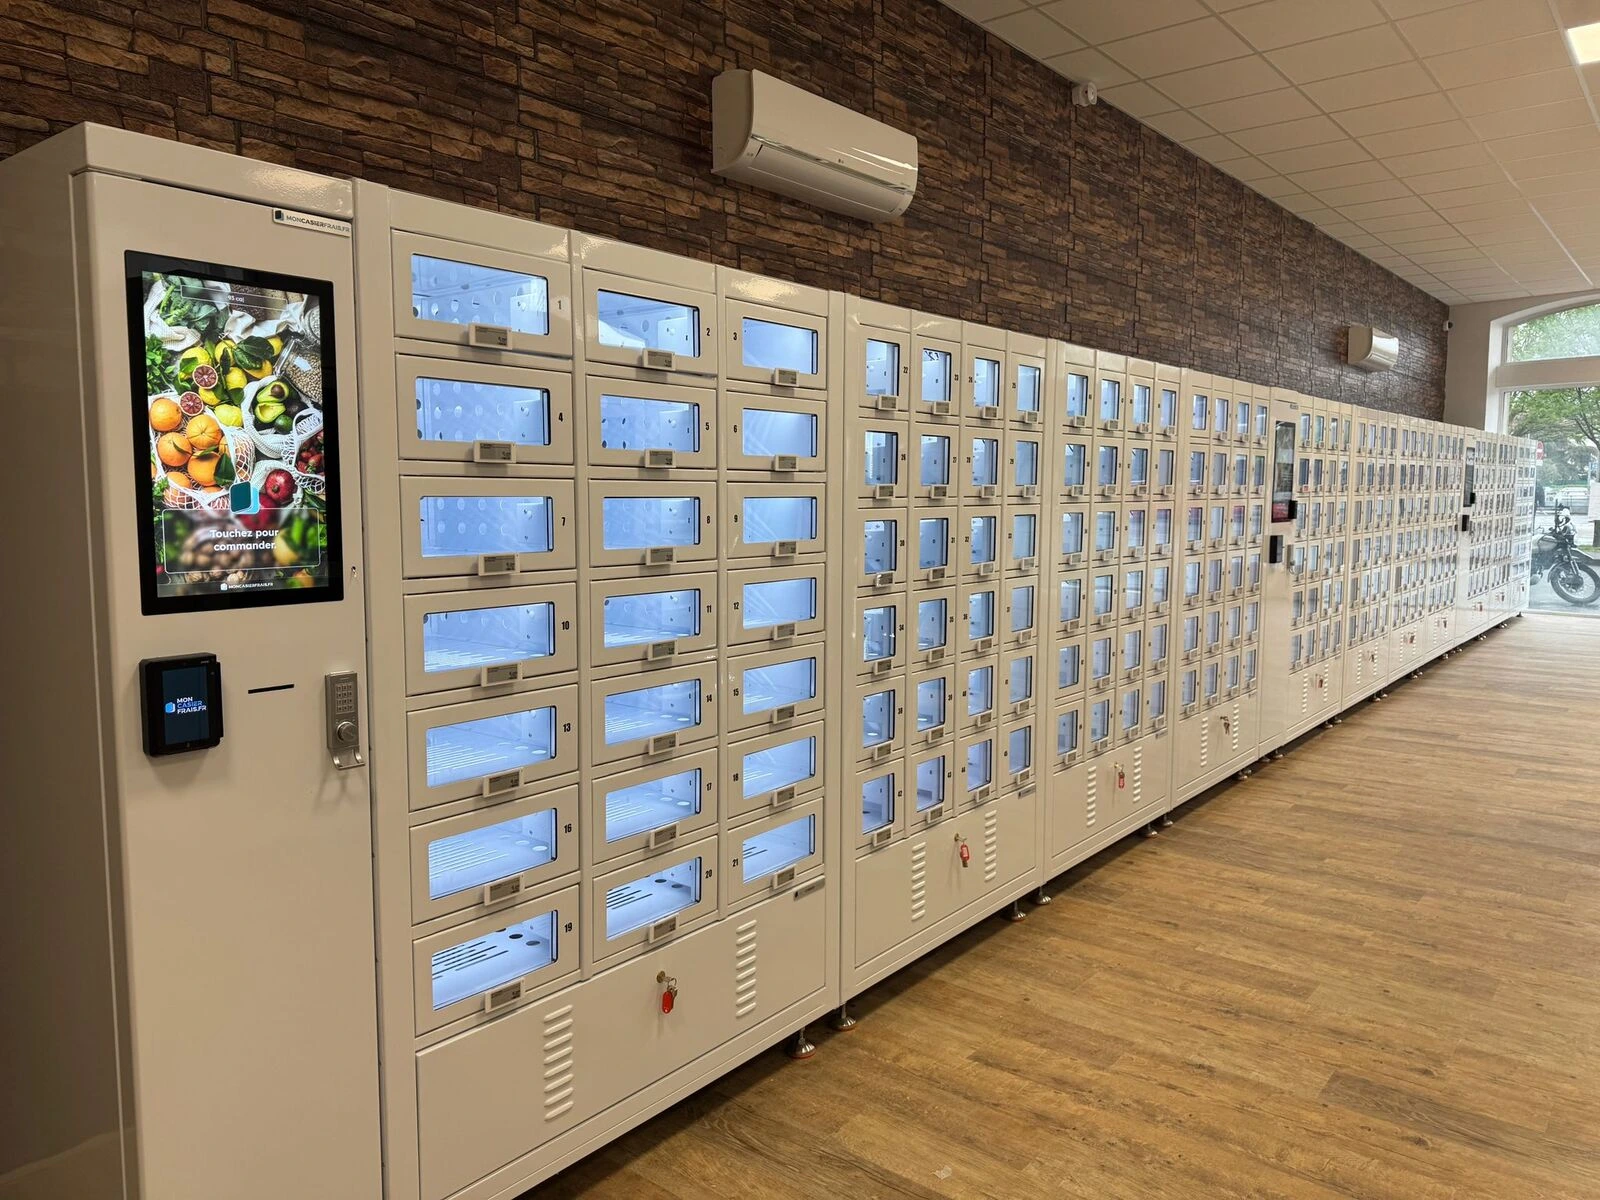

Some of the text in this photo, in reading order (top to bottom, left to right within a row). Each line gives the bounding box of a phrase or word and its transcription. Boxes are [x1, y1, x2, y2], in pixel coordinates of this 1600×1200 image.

[209, 529, 279, 539] Touchez pour
[213, 541, 276, 551] commander.
[706, 604, 712, 614] 11
[734, 602, 740, 610] 12
[562, 620, 570, 630] 10
[732, 688, 740, 696] 15
[706, 694, 713, 702] 14
[177, 700, 202, 708] CASIER
[562, 722, 571, 732] 13
[706, 782, 713, 792] 17
[564, 824, 572, 834] 16
[732, 858, 739, 868] 21
[706, 868, 713, 878] 20
[564, 922, 573, 932] 19
